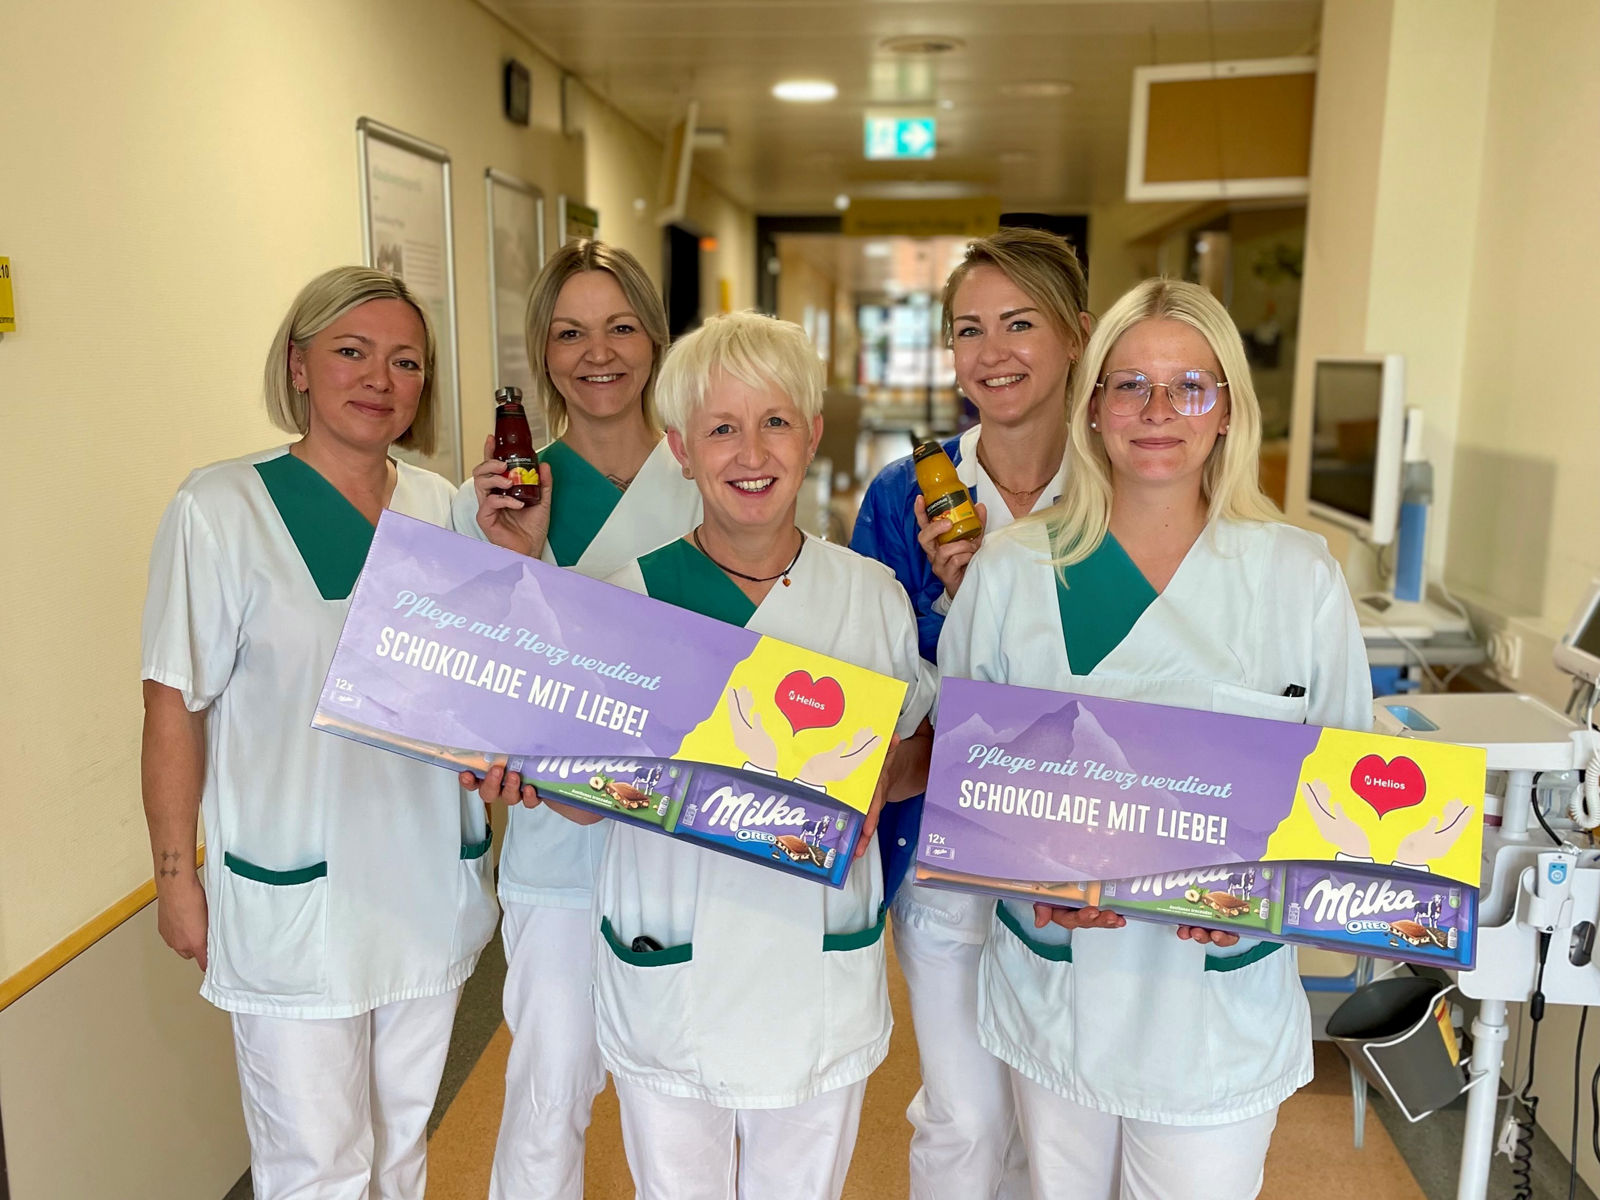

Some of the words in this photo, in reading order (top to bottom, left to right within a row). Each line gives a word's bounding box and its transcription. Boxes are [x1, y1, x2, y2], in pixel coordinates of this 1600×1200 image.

[393, 590, 468, 629] Pflege
[468, 621, 512, 642] mit
[514, 628, 570, 666] Herz
[571, 654, 661, 691] verdient
[335, 678, 354, 692] 12x
[375, 626, 527, 699] SCHOKOLADE
[527, 674, 575, 713] MIT
[575, 690, 649, 738] LIEBE!
[795, 693, 826, 711] Helios
[967, 744, 1037, 774] Pflege
[1038, 759, 1079, 776] mit
[1083, 760, 1138, 790] Herz
[1141, 775, 1232, 799] verdient
[1373, 777, 1406, 790] Helios
[701, 786, 810, 831] Milka
[958, 779, 1102, 827] SCHOKOLADE
[1107, 800, 1151, 834] MIT
[1156, 807, 1228, 846] LIEBE!
[736, 829, 777, 843] OREO
[928, 832, 946, 845] 12x
[1303, 879, 1420, 926] Milka
[1347, 920, 1389, 934] OREO
